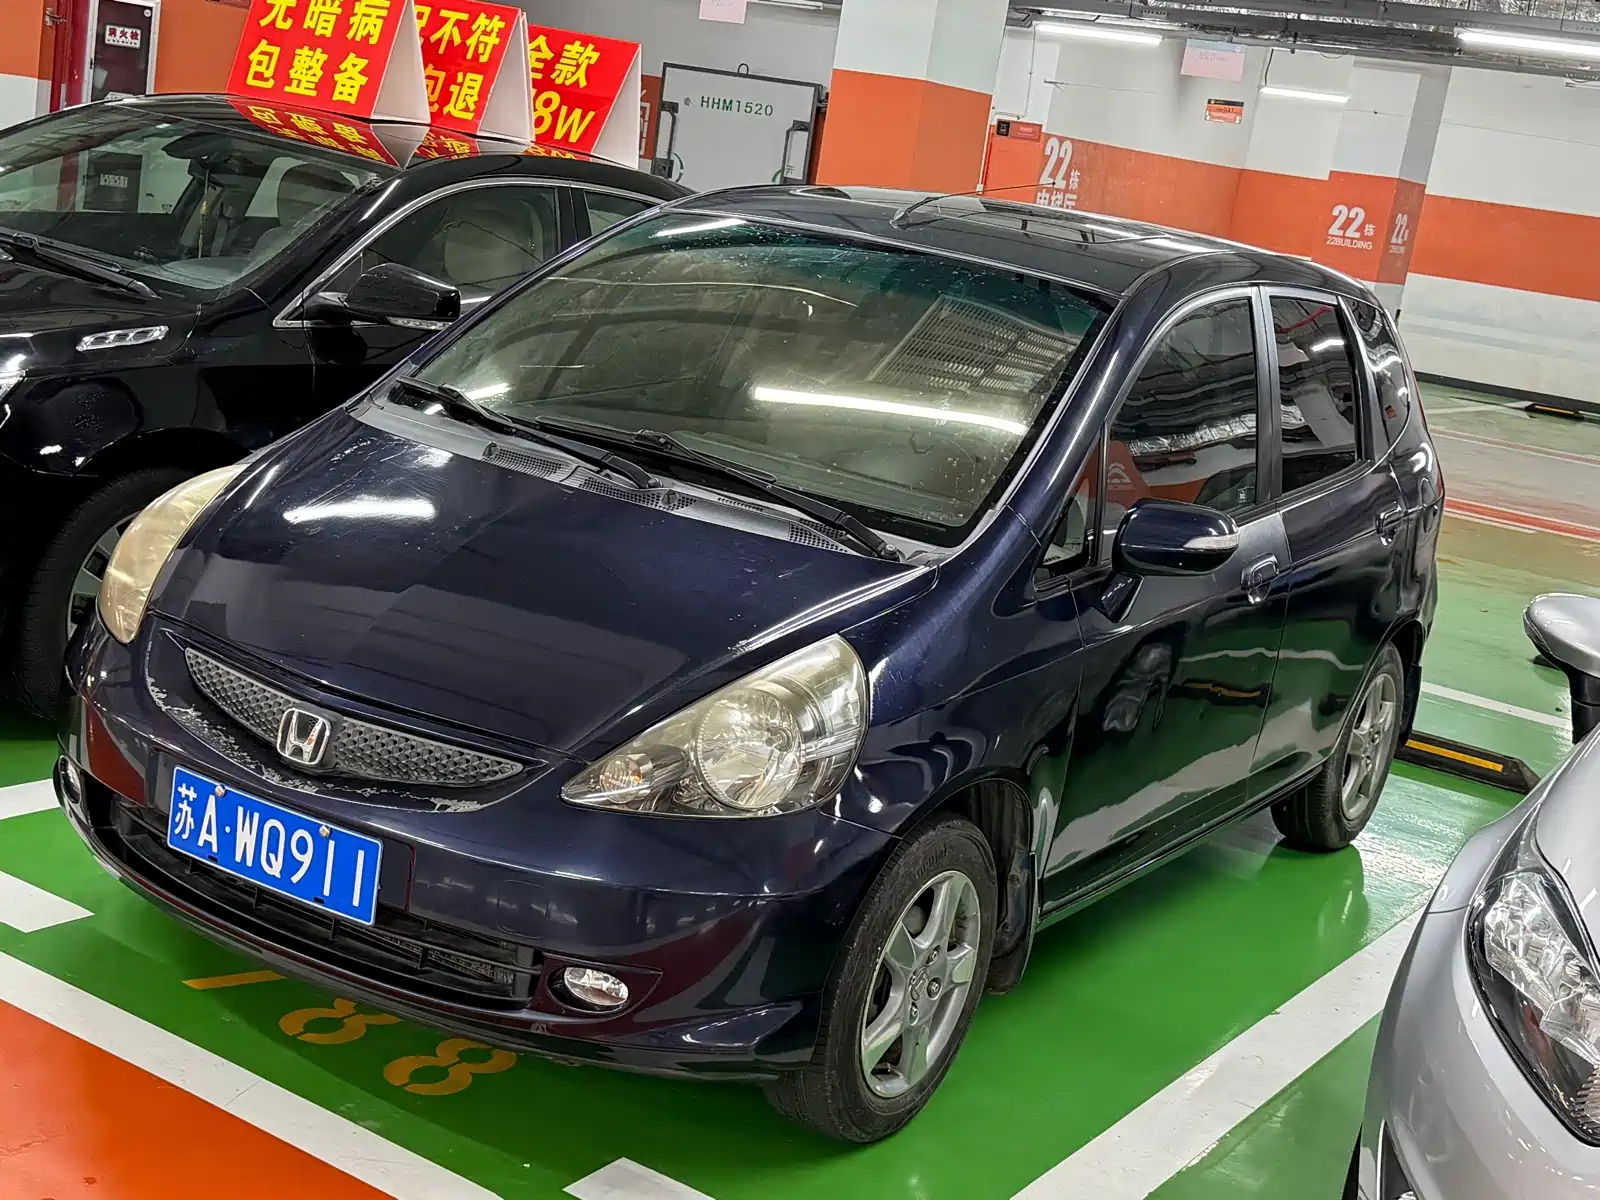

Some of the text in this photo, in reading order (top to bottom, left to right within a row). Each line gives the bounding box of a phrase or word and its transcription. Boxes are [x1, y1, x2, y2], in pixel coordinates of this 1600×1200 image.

[246, 39, 369, 104] 包整备
[700, 96, 774, 117] HHM1520
[1326, 236, 1373, 251] 22BUILDING
[173, 782, 366, 908] 苏A·WQ911
